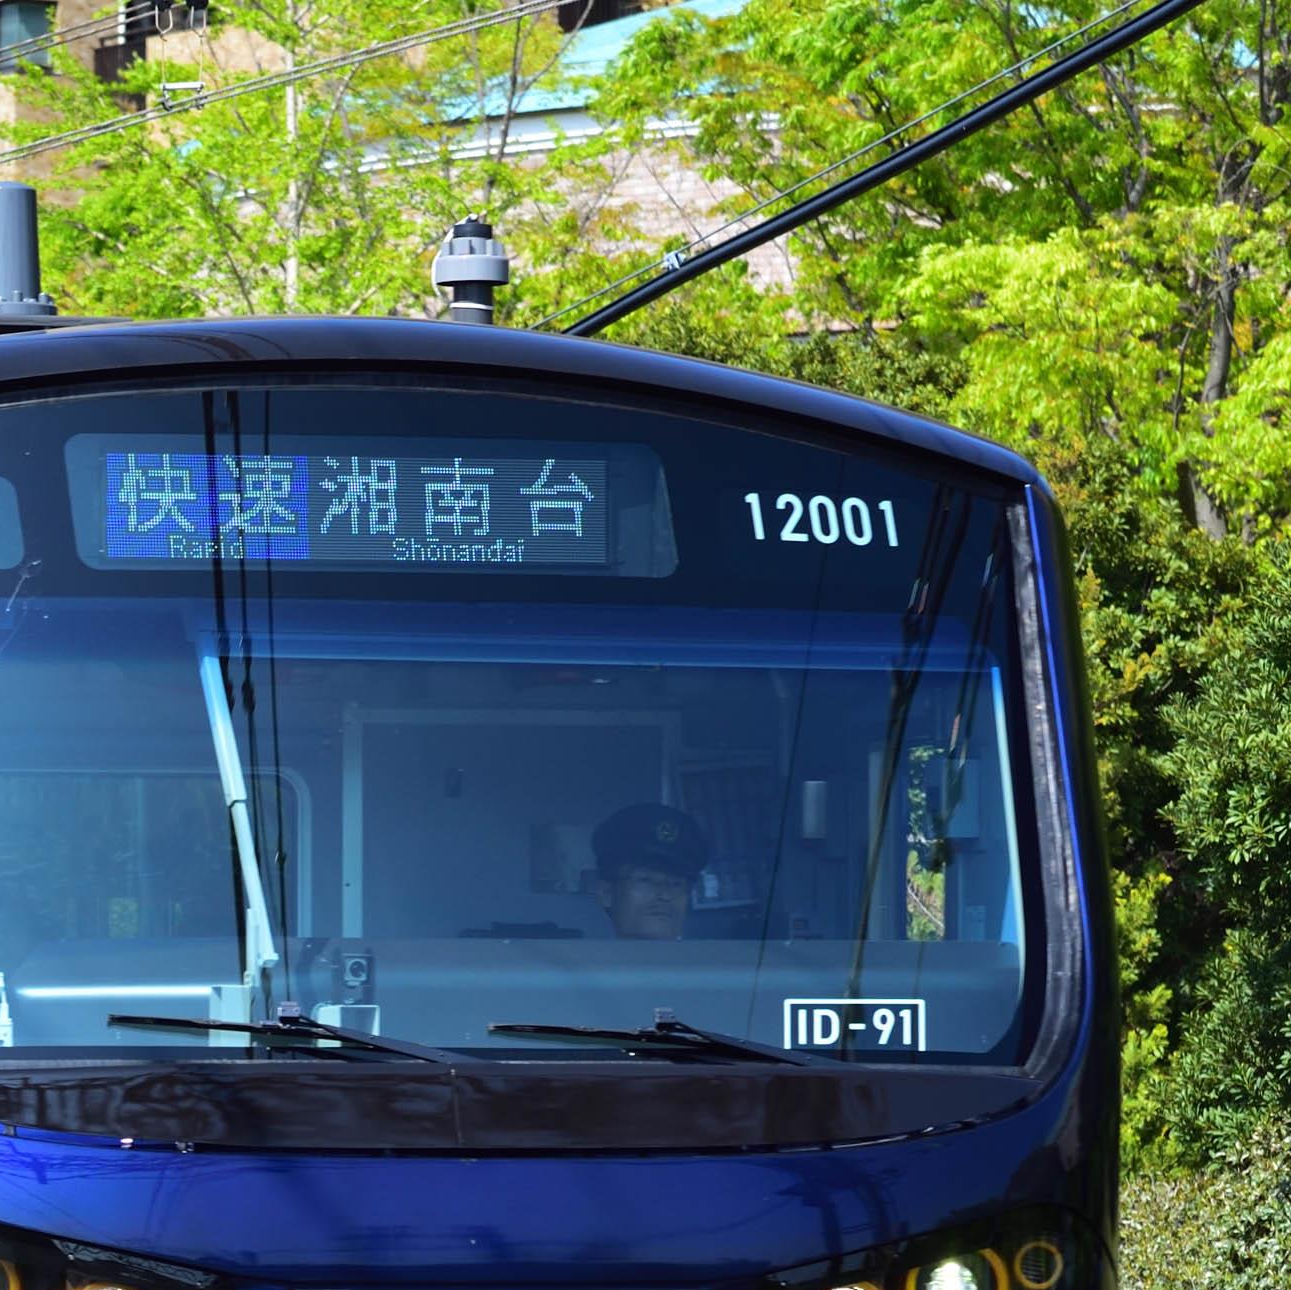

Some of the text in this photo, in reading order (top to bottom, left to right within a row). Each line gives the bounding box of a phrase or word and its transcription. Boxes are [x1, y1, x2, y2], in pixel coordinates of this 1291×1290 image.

[118, 453, 594, 536] 快速 湘南台
[744, 492, 899, 547] 12001
[169, 535, 244, 559] Rapid
[797, 1008, 913, 1045] ID-91
